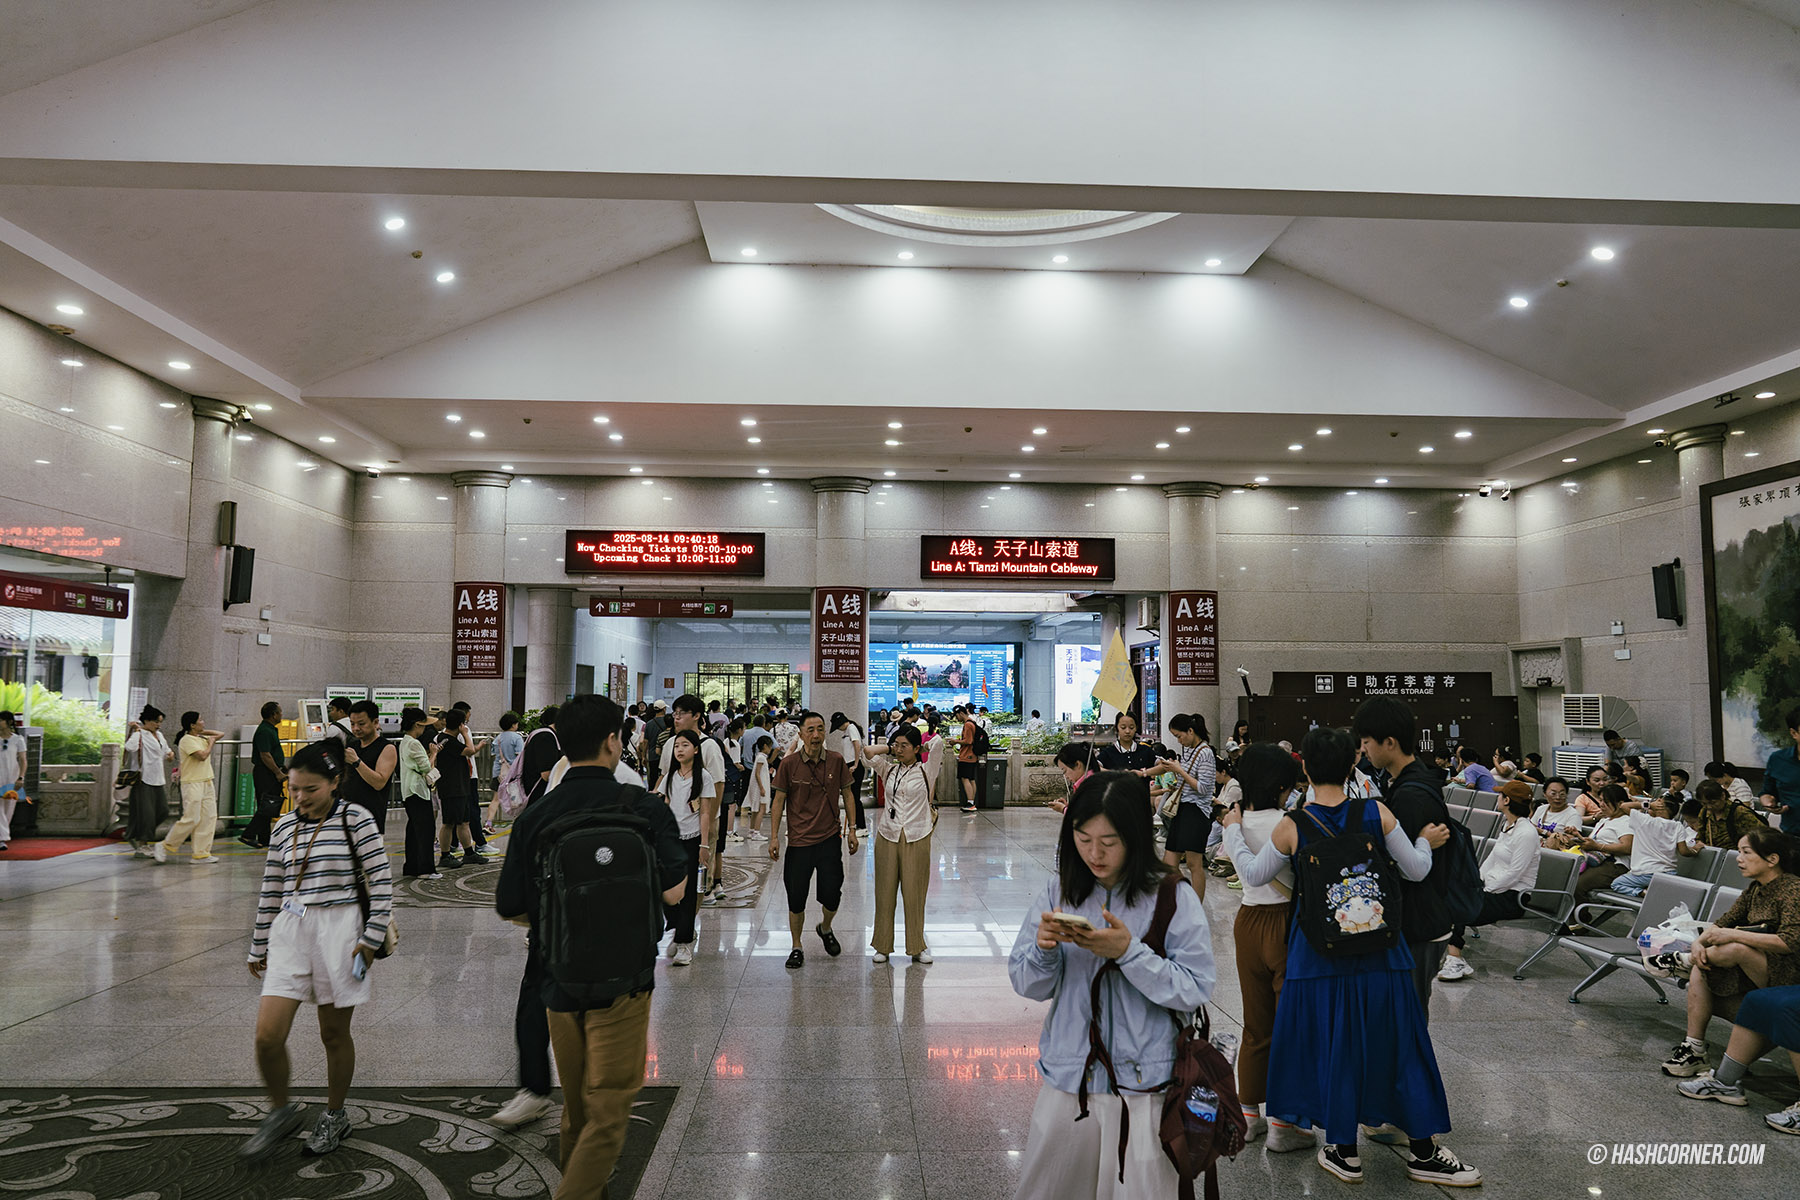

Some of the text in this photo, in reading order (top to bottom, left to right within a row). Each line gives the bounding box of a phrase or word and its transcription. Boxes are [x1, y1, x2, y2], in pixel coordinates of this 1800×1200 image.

[614, 534, 718, 544] 2025-08-14 09:40:18
[578, 543, 753, 554] Now Checking Tickets 09:00-10:00
[594, 553, 736, 564] Upcoming Check 10:00-11:00
[931, 561, 1098, 576] Line A: Tianzi Mountain Cableway
[456, 629, 498, 638] 天子山索道
[821, 633, 860, 642] 天子山索道
[1176, 637, 1215, 646] 天子山索道
[1347, 675, 1456, 688] 自助行李寄存
